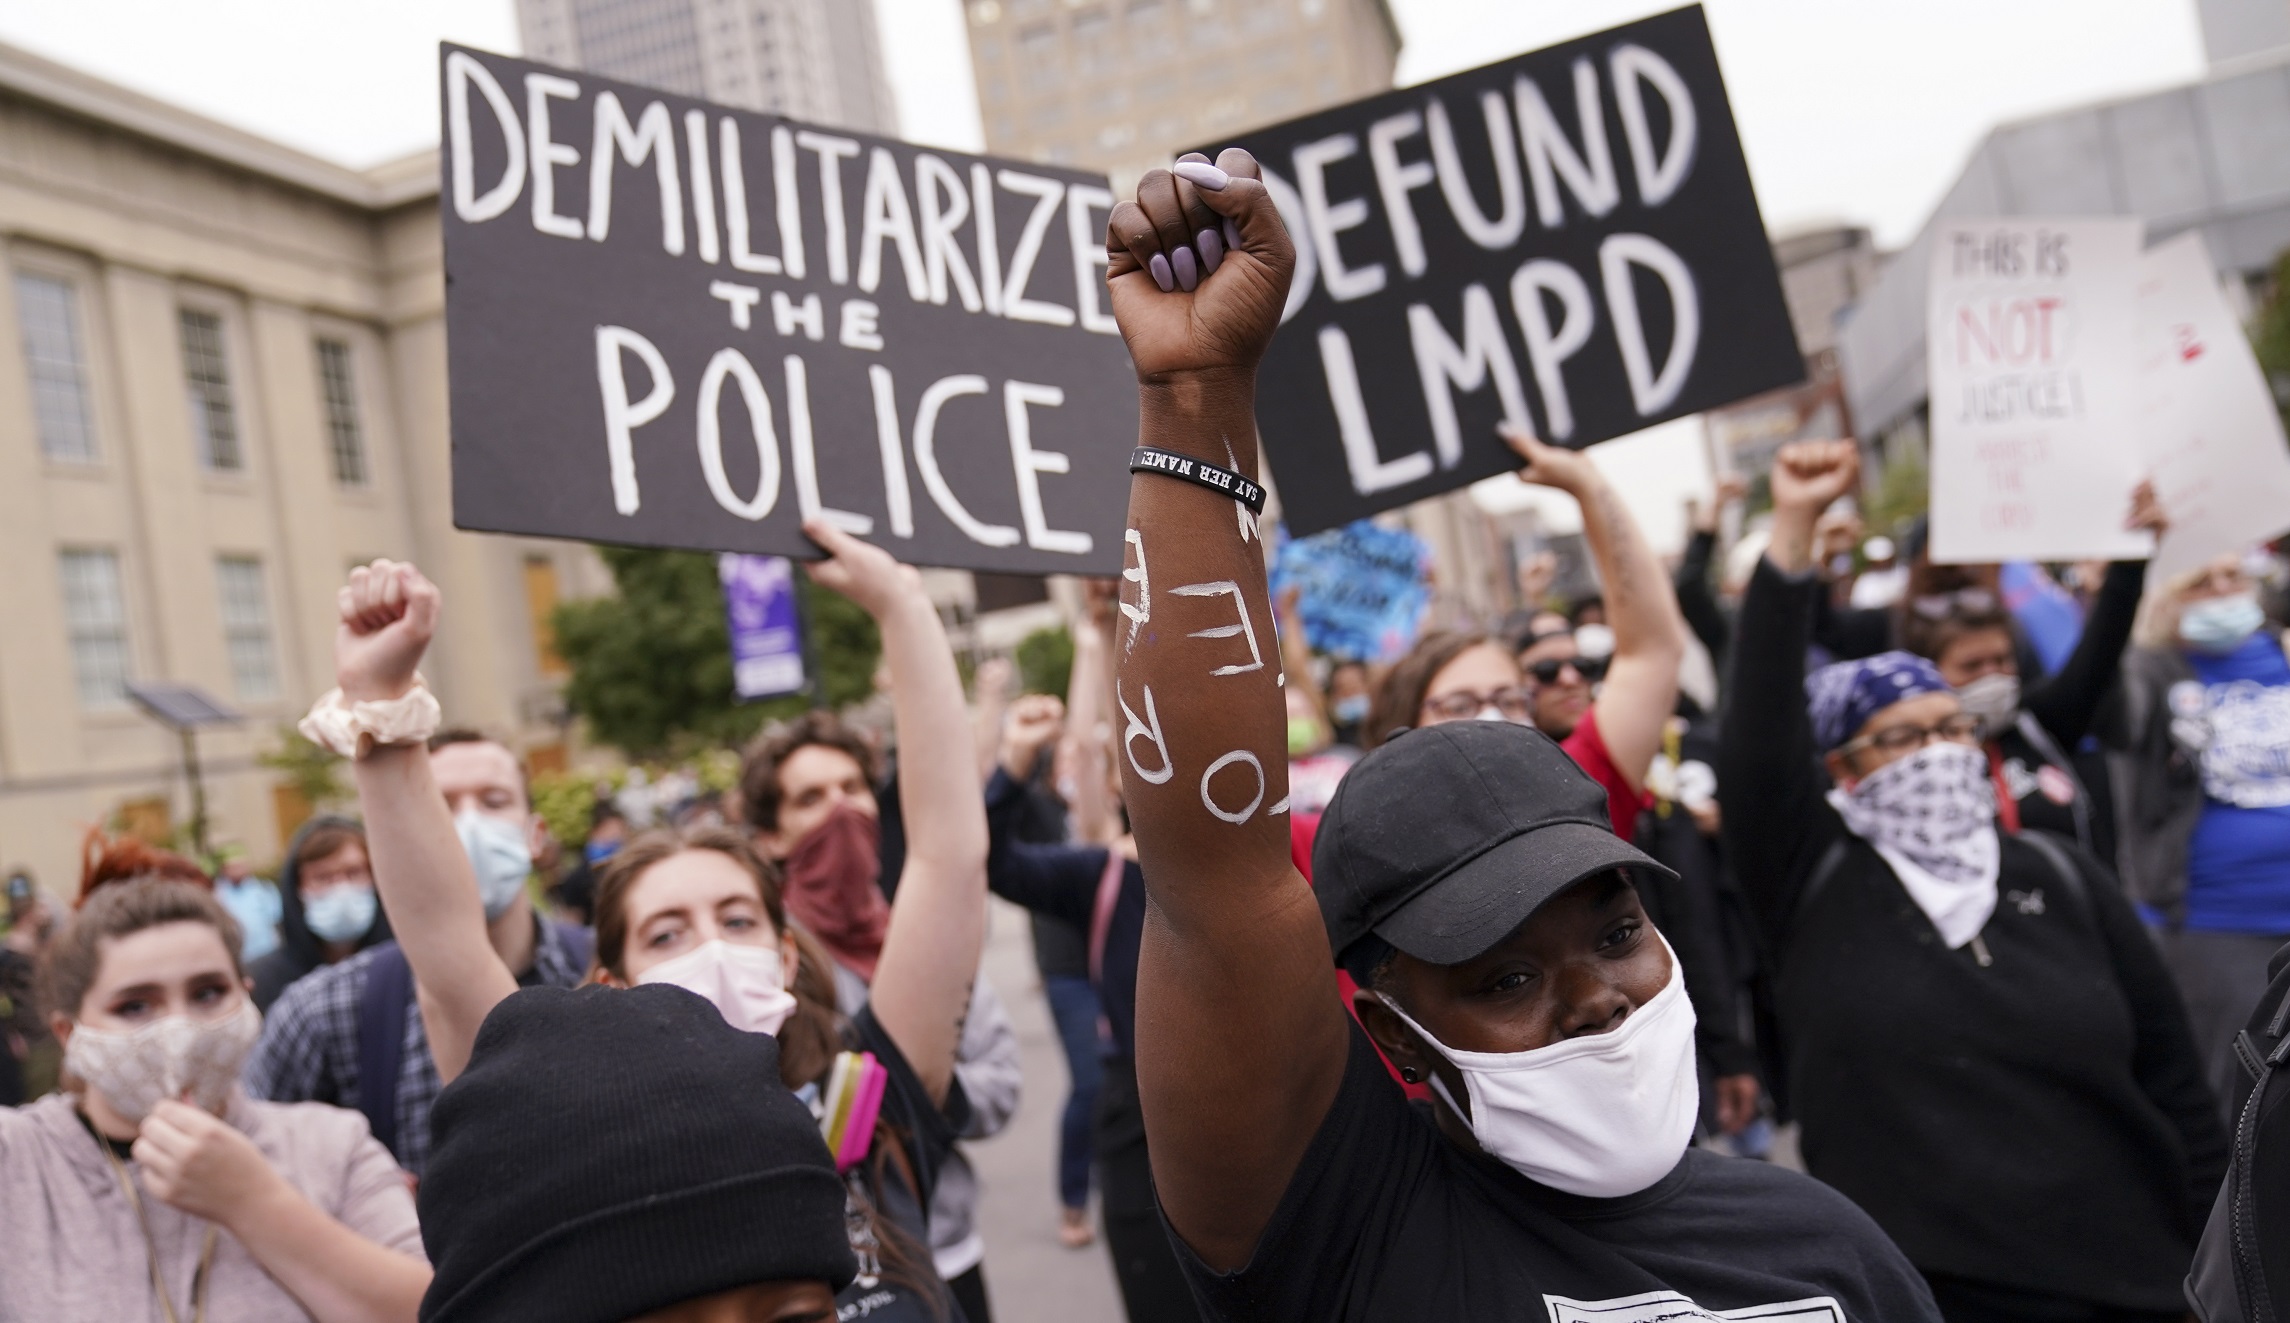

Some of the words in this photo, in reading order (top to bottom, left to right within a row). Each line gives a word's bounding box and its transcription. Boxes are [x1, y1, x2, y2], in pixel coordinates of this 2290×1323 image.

[446, 51, 1121, 335] DEMILITARIZE
[1952, 229, 2029, 279] THIS
[2033, 228, 2071, 279] IS
[710, 280, 885, 351] THE
[1955, 297, 2066, 368] NOT
[1318, 232, 1701, 496] LMPD
[596, 324, 1093, 554] POLICE
[1140, 451, 1194, 476] NAME!
[1199, 464, 1232, 489] HER
[1235, 480, 1258, 502] SAY
